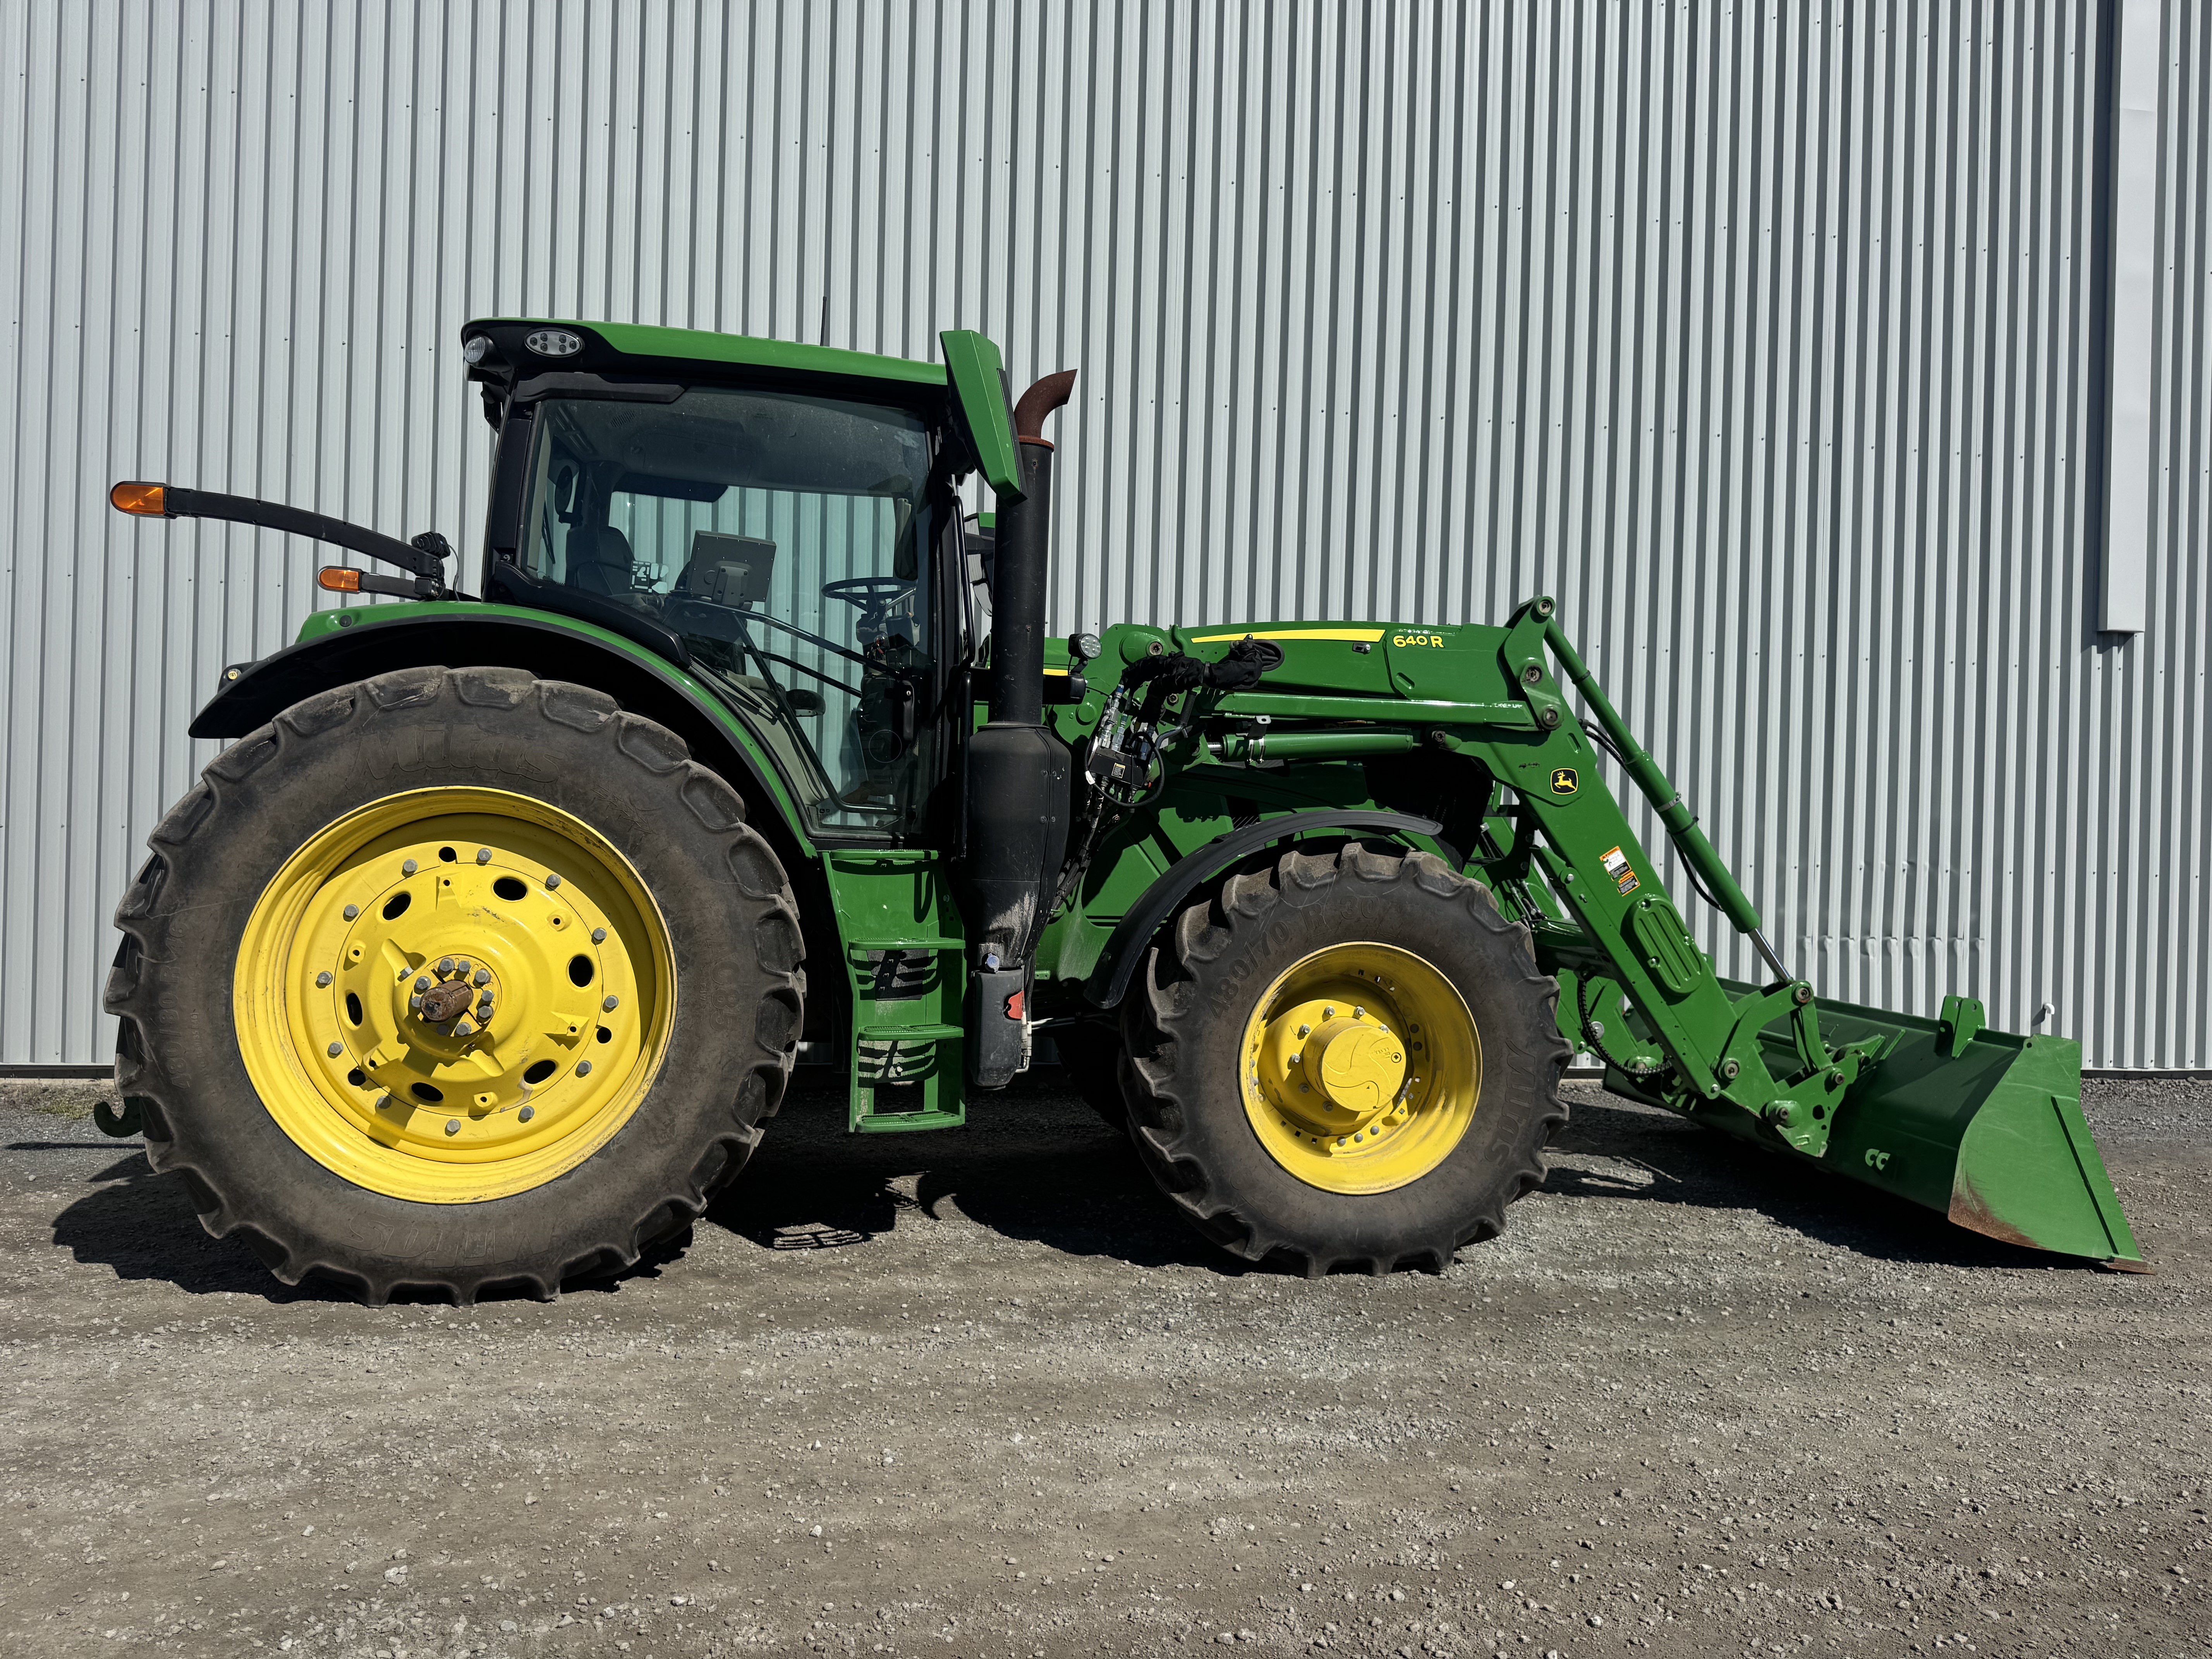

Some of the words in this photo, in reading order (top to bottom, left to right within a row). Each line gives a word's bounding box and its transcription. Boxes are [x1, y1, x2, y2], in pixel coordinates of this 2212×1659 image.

[1393, 635, 1428, 647] 640
[1430, 635, 1444, 648] R
[344, 719, 565, 790] Mitas
[1207, 921, 1290, 1019] 480/70
[1300, 903, 1328, 931] R
[1340, 895, 1380, 920] 30
[159, 992, 191, 1089] 480/80
[1484, 1040, 1535, 1167] Mitas
